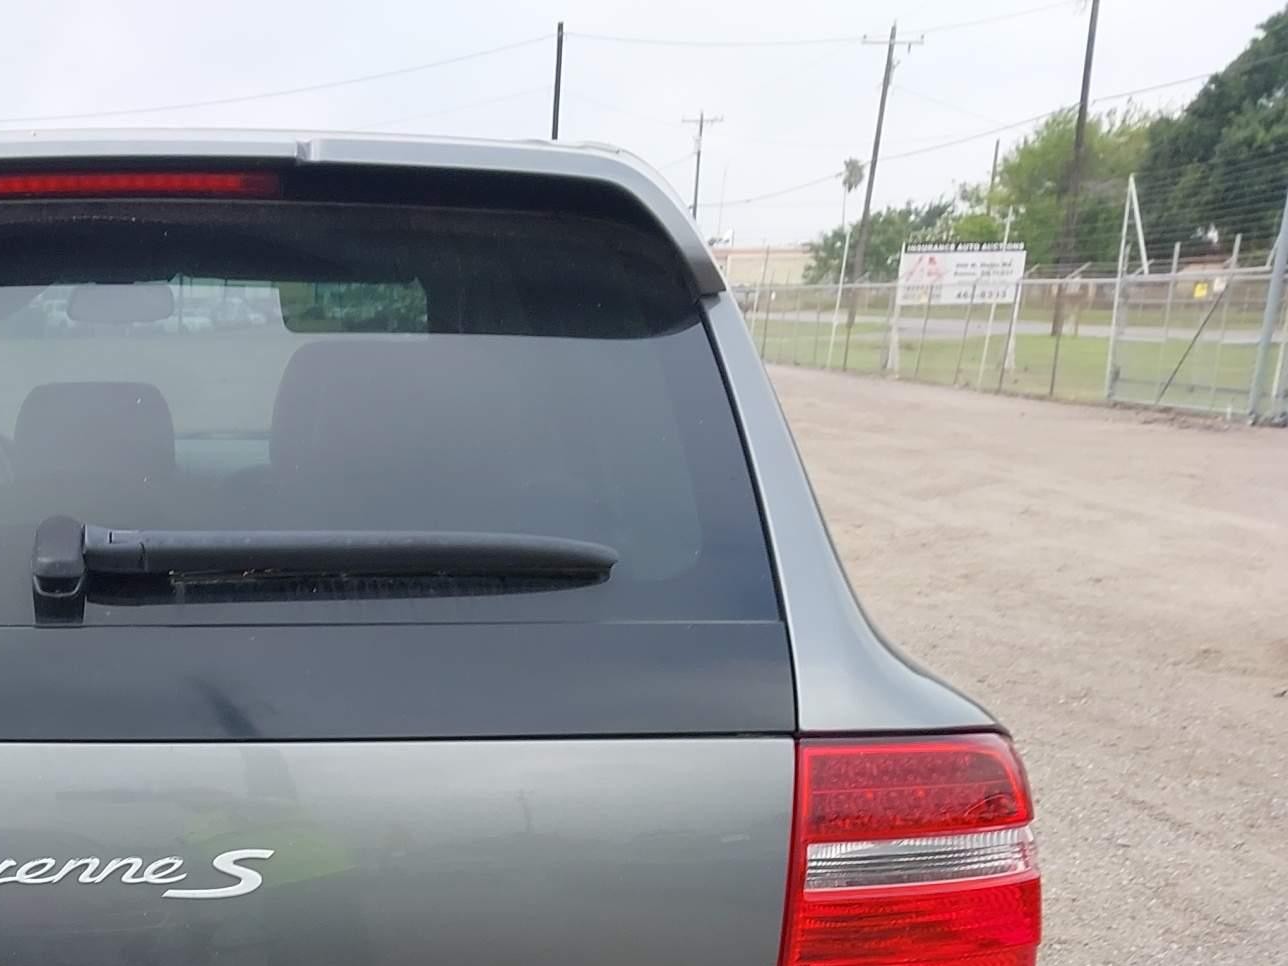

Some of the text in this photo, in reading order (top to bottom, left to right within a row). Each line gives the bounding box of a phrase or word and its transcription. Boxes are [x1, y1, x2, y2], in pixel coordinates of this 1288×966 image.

[906, 243, 955, 253] INSURANCE
[957, 242, 980, 252] AUTO
[161, 848, 275, 899] S
